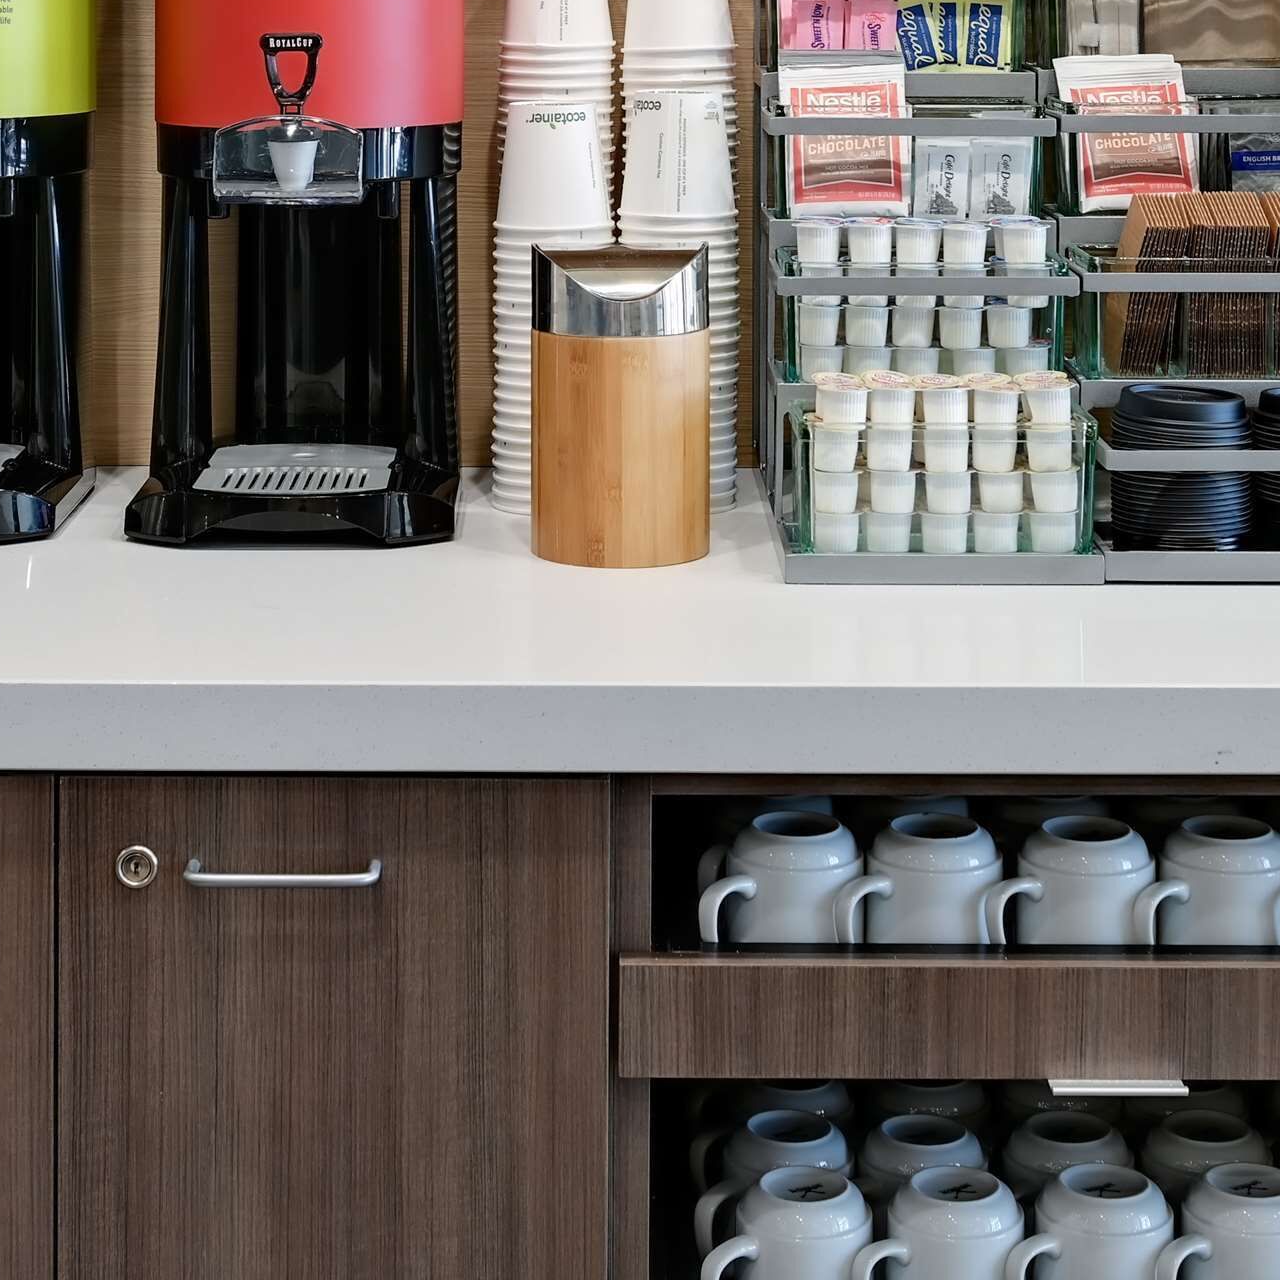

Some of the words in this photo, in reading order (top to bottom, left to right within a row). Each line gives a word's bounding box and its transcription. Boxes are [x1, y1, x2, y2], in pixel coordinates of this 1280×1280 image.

[898, 8, 935, 70] equal
[971, 4, 995, 65] equal
[528, 111, 586, 124] ecotainer
[808, 136, 886, 155] CHOCOLATE
[1095, 133, 1171, 150] CHOCOLATE
[1243, 155, 1271, 163] ENGLISH
